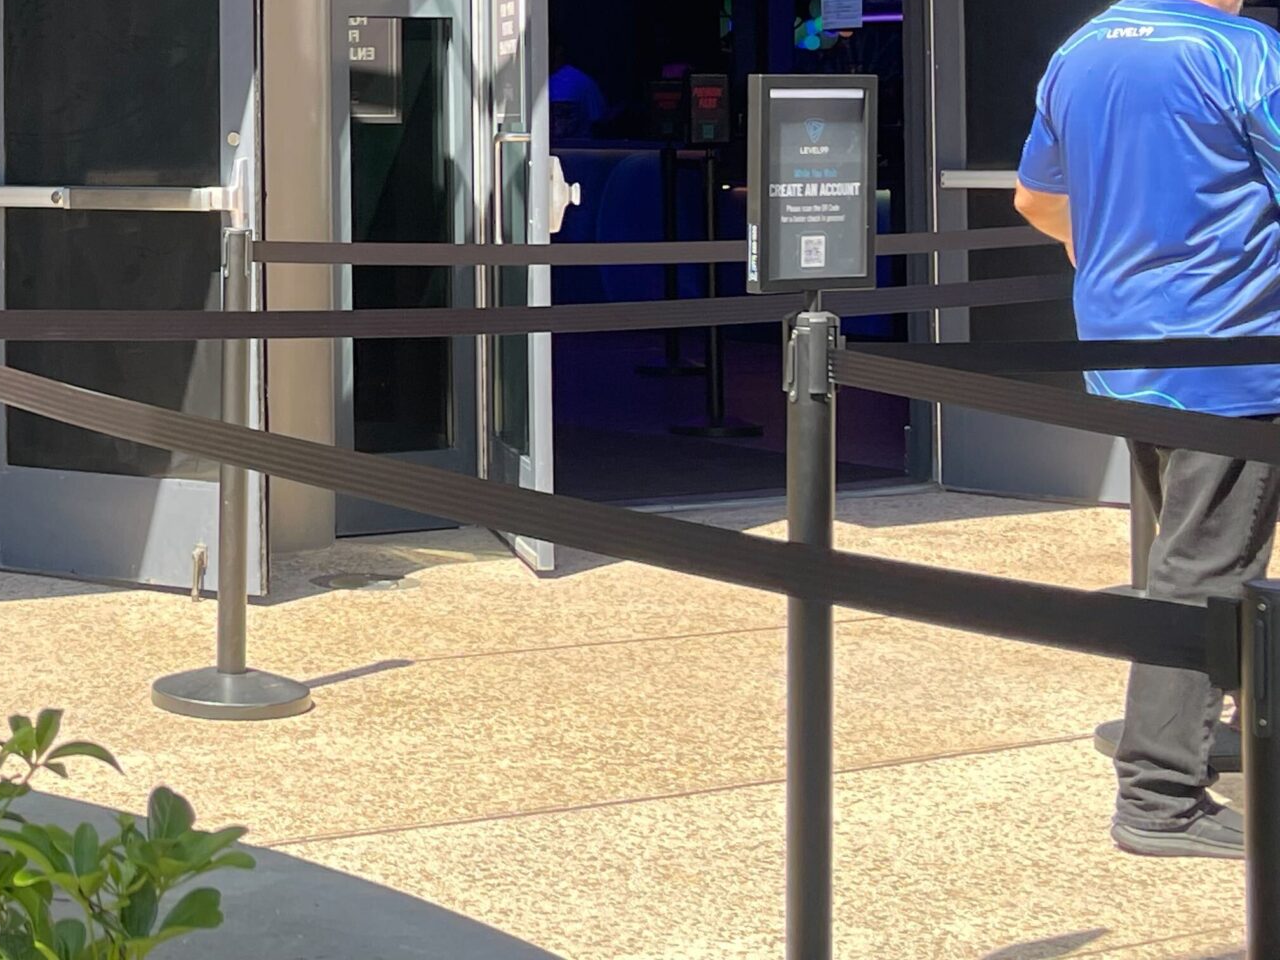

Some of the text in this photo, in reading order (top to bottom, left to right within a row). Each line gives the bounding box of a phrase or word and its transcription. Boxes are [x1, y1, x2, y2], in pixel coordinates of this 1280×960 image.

[1106, 26, 1155, 39] LEVEL99
[799, 146, 829, 155] LEVEL99
[769, 182, 861, 197] CREATE AN ACCOUNT
